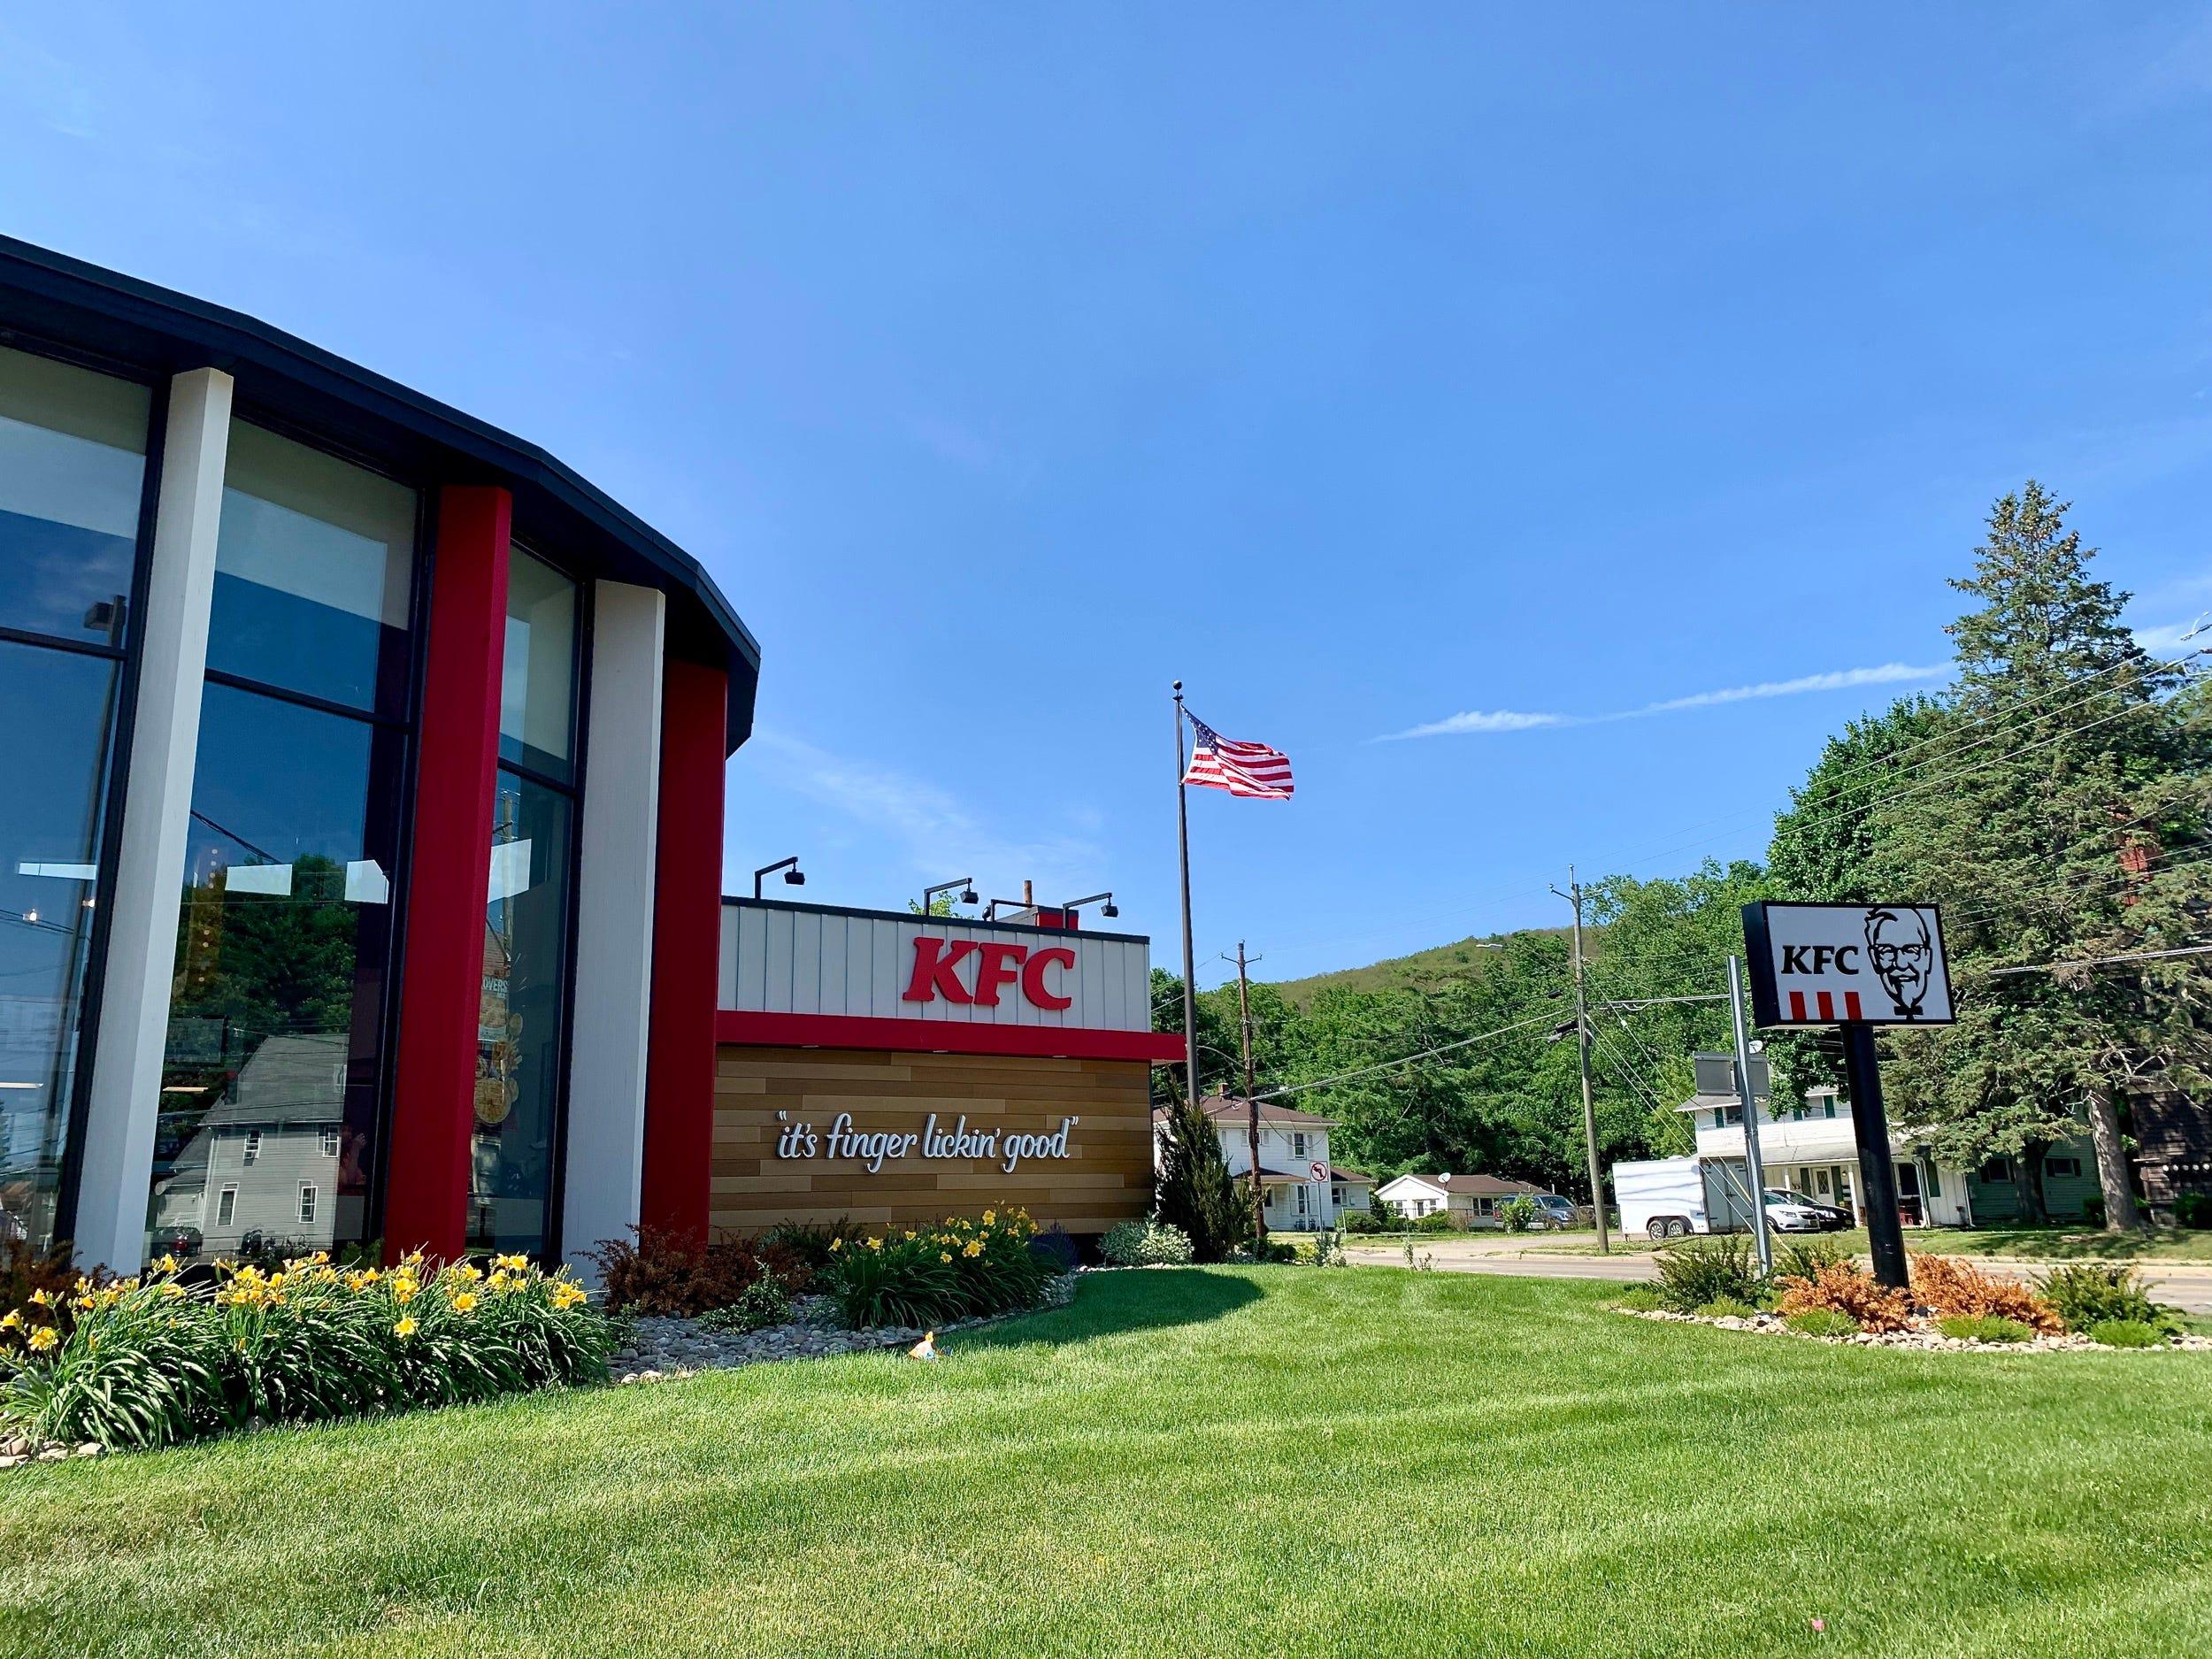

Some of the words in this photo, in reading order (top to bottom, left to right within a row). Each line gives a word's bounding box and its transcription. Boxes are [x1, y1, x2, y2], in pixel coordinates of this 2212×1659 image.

[902, 936, 1075, 1010] KFC
[1780, 945, 1859, 975] KFC
[481, 976, 510, 993] OVERS
[825, 1112, 918, 1173] finger
[921, 1113, 1001, 1158] lickin'
[1000, 1116, 1079, 1173] good"
